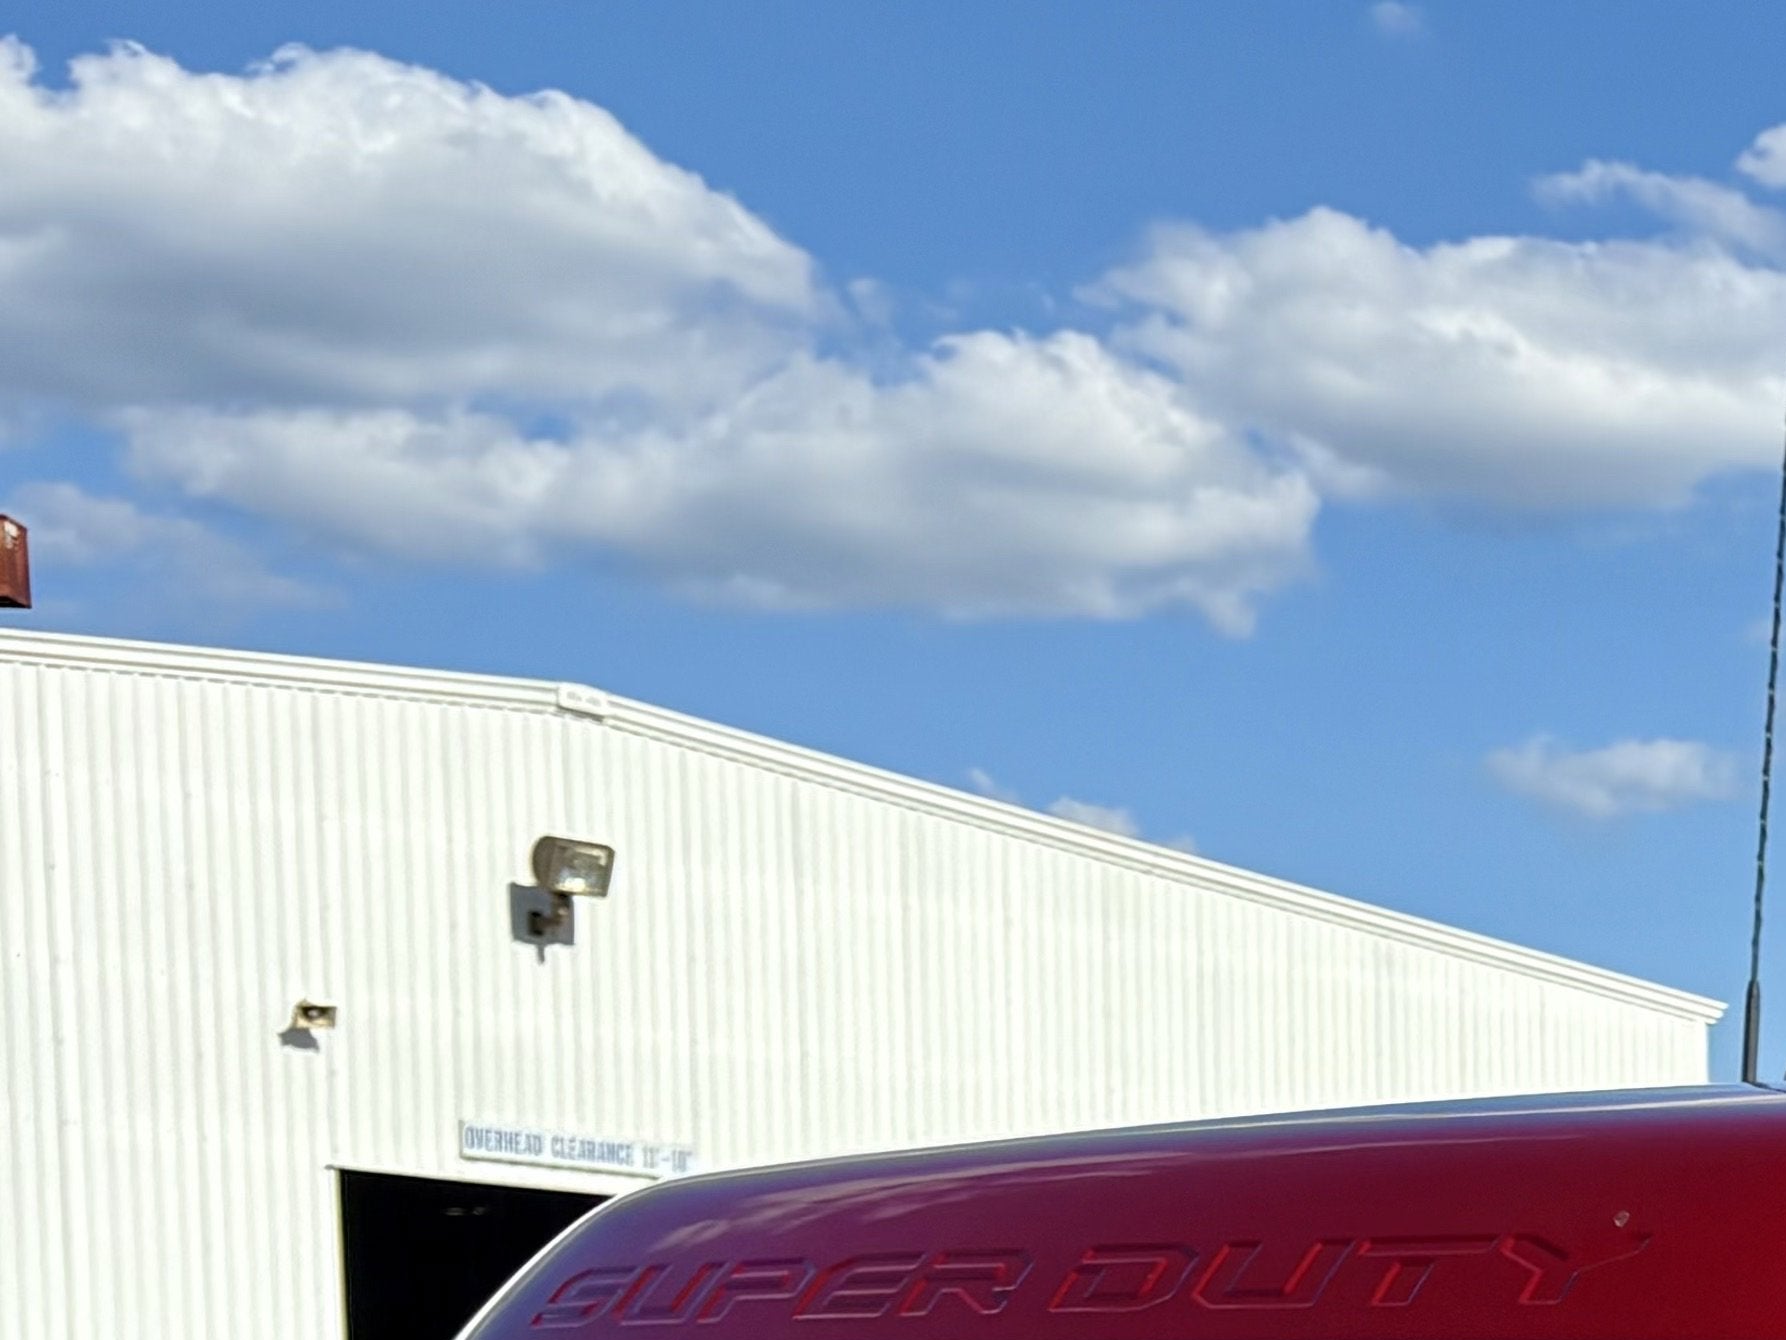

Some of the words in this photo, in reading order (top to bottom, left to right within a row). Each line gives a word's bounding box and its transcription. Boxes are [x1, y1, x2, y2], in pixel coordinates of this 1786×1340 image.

[464, 1126, 543, 1156] OVERHEAD
[551, 1135, 634, 1167] CLEARANCE
[529, 1247, 1035, 1329] SUPER
[1047, 1232, 1652, 1313] DUTY
